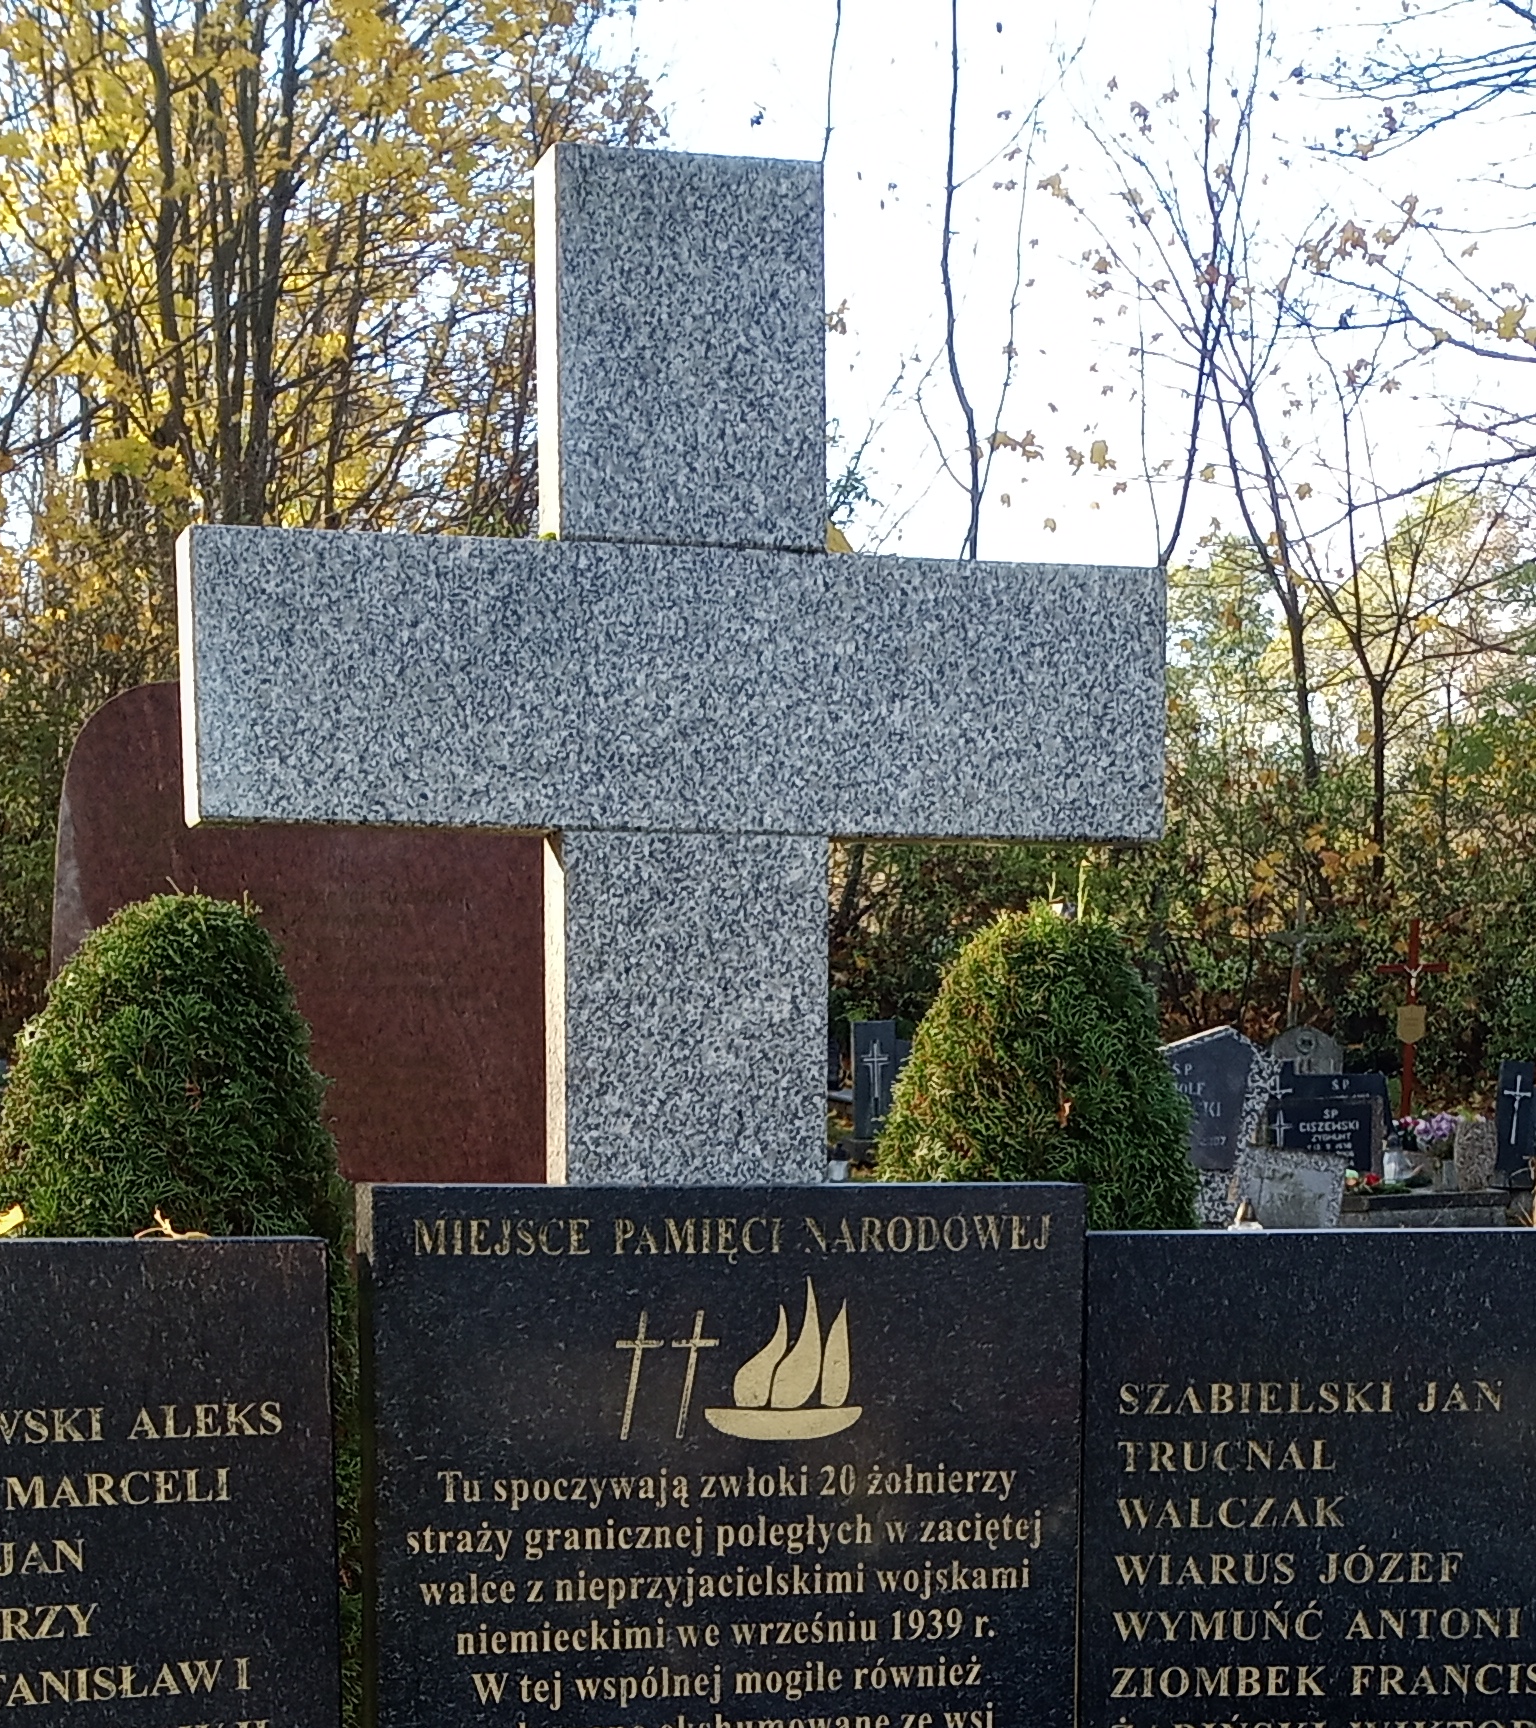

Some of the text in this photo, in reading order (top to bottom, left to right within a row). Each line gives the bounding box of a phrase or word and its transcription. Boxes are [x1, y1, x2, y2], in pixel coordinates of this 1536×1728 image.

[414, 1215, 1051, 1263] MIEJSCE PAMIĘCI NARODOWEJ
[1120, 1381, 1503, 1414] SZABIELSKI JAN
[130, 1402, 281, 1440] ALEKS
[7, 1468, 229, 1510] MARCELI
[438, 1467, 1015, 1508] Tu spoczywają zwłoki 20 żołnierzy
[1118, 1497, 1345, 1529] WALCZAK
[408, 1513, 1041, 1560] straży granicznej poległych w zaciętej
[1116, 1545, 1462, 1585] WIARUS JÓZEF
[420, 1564, 1029, 1610] walce z nieprzyjacielskimi wojskami
[458, 1609, 995, 1655] niemieckimi we wrześniu 1939 r.
[1114, 1602, 1521, 1641] WYMUŃĆ ANTONI
[239, 1658, 250, 1690] I
[473, 1656, 980, 1709] W tej wspólnej mogile również
[1111, 1665, 1325, 1697] ZIOMBEK
